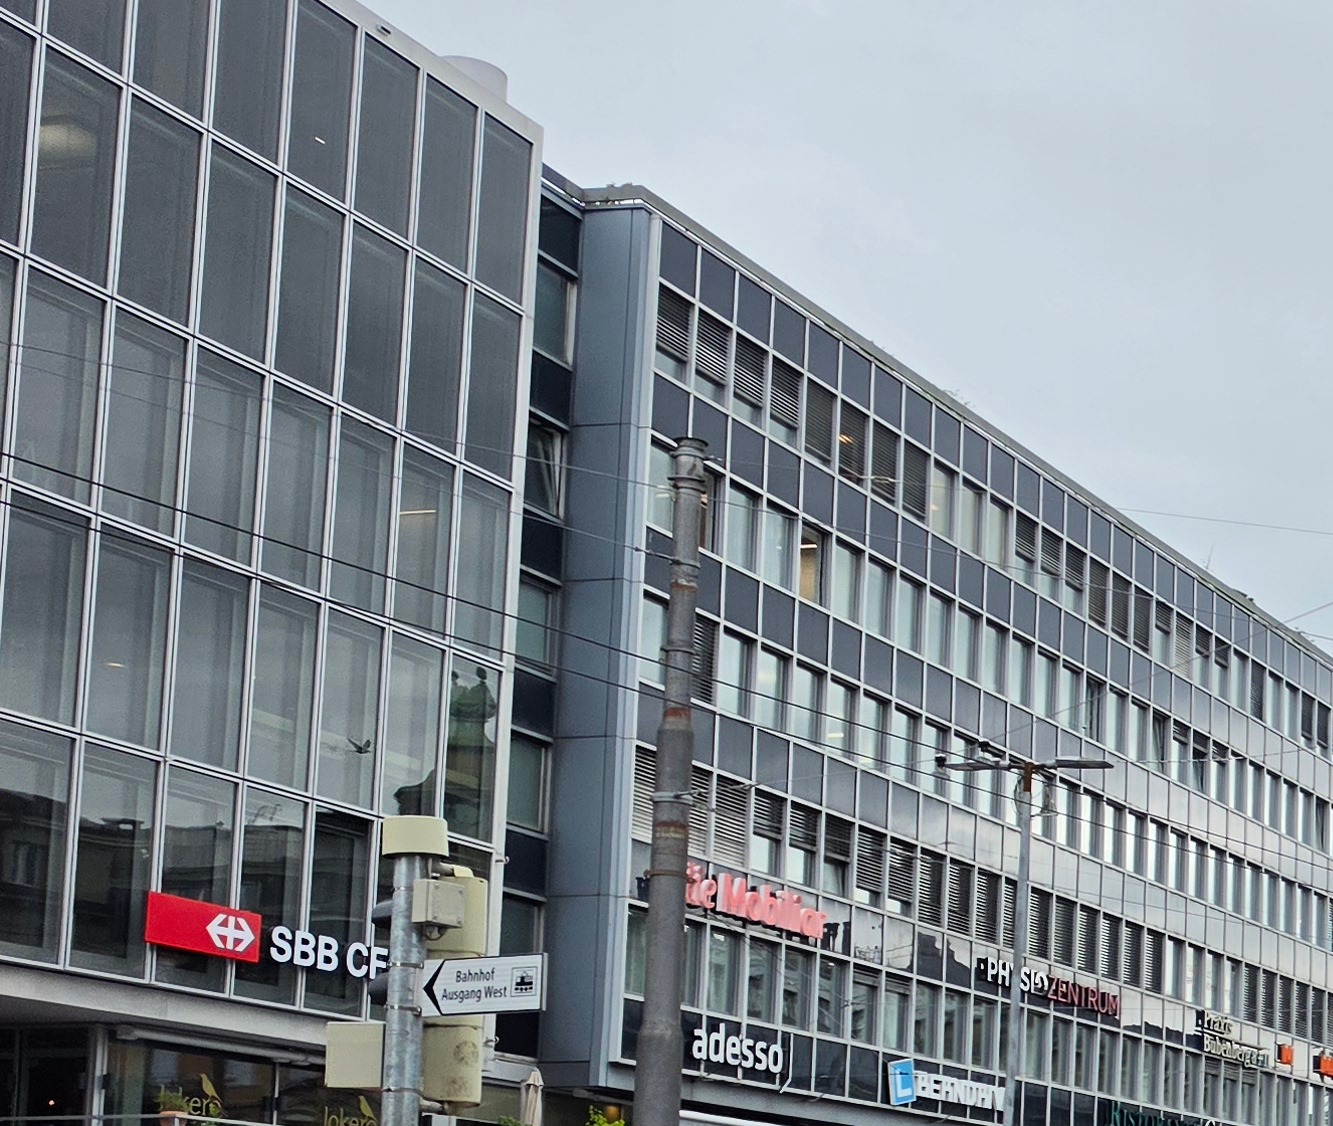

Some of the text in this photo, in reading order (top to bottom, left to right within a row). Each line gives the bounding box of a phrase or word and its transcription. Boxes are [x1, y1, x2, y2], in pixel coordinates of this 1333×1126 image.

[269, 925, 389, 980] SBB CF
[455, 967, 496, 983] Bahnhof
[441, 985, 508, 1003] Ausgang West
[692, 1022, 784, 1074] adesso
